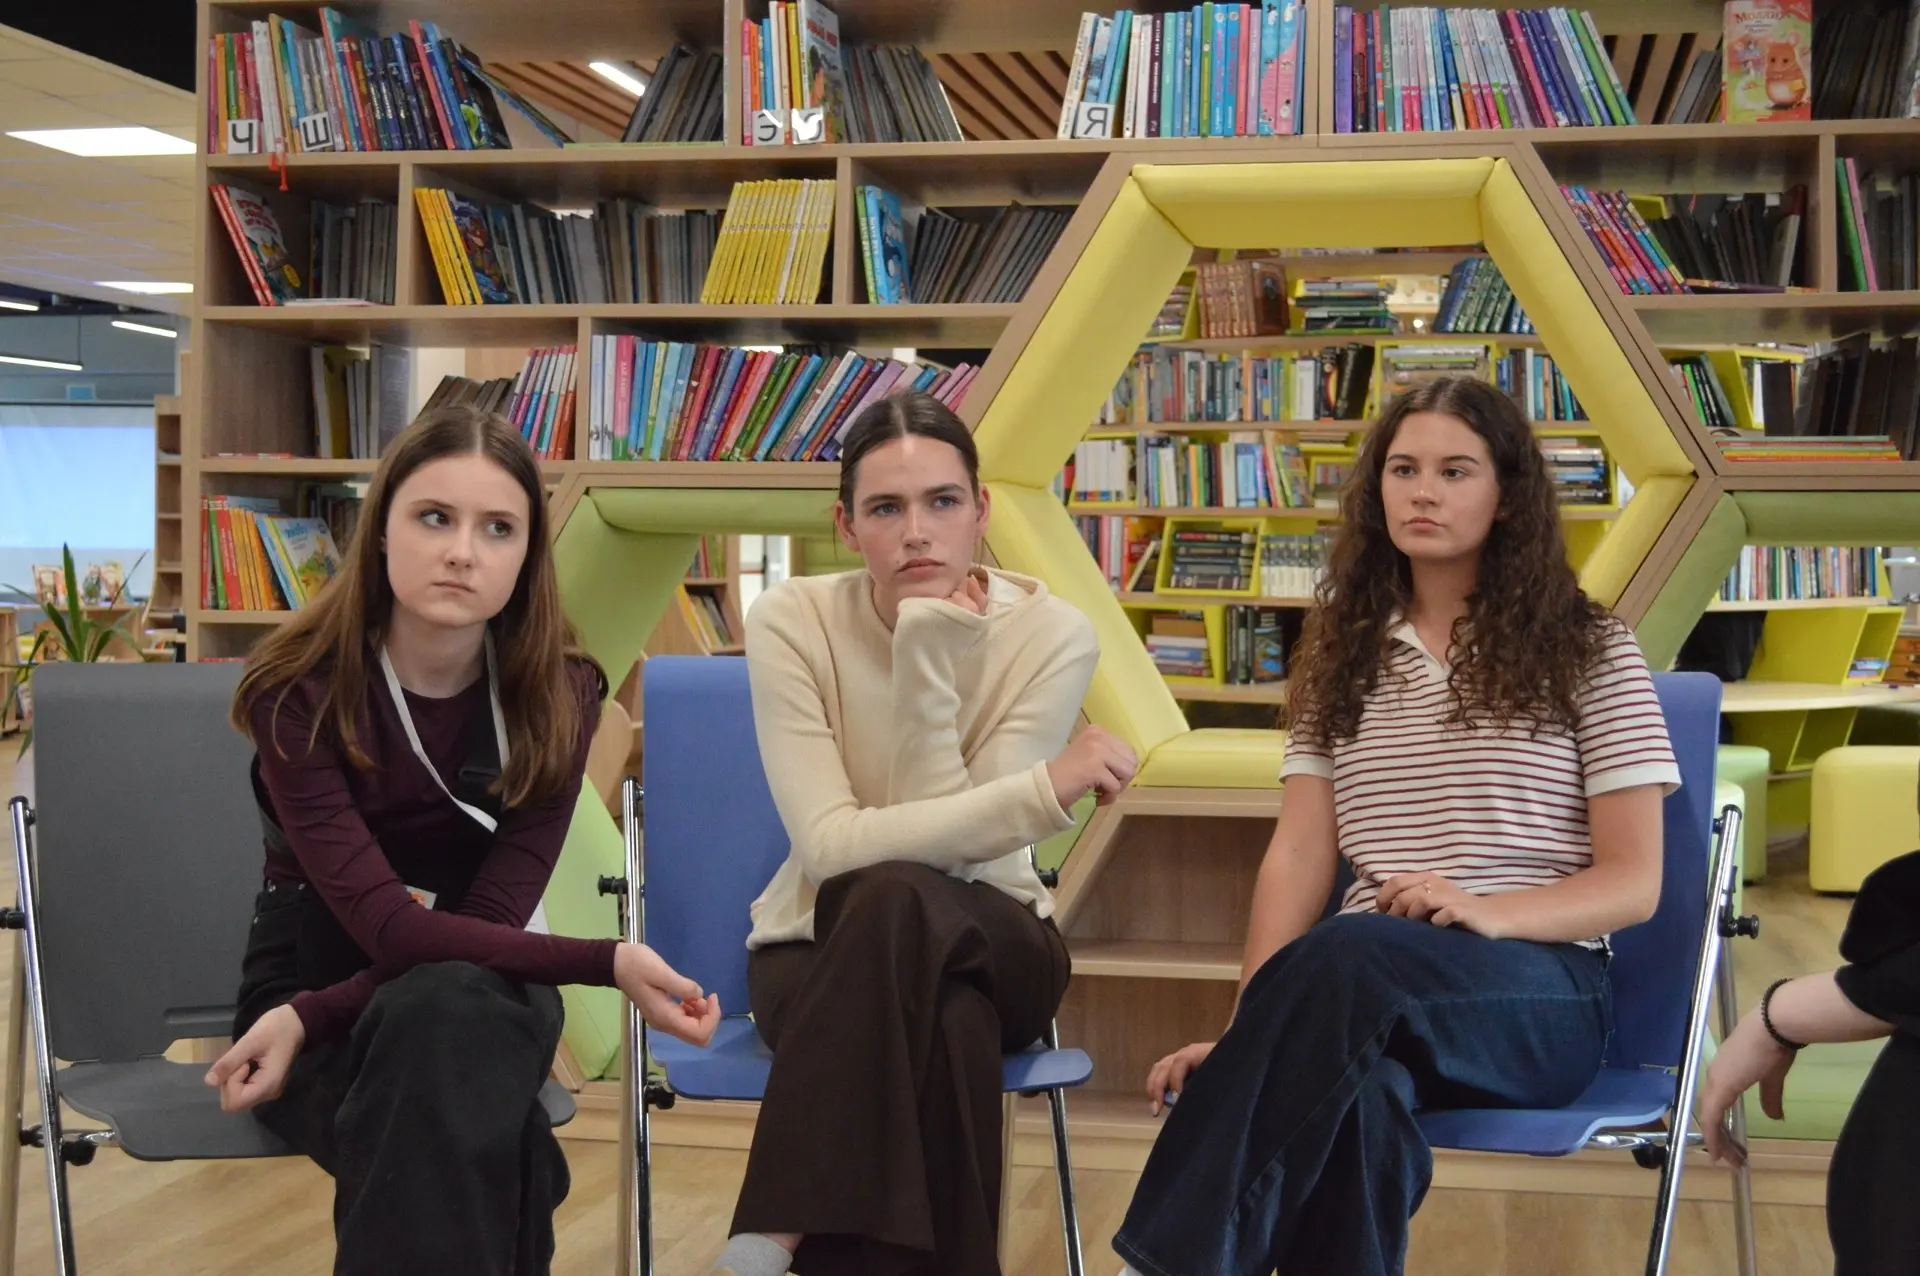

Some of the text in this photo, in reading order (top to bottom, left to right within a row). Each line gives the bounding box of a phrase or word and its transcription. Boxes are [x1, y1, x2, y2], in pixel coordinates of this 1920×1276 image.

[231, 122, 253, 152] Ч
[302, 117, 331, 148] Ш
[1083, 106, 1109, 137] Я
